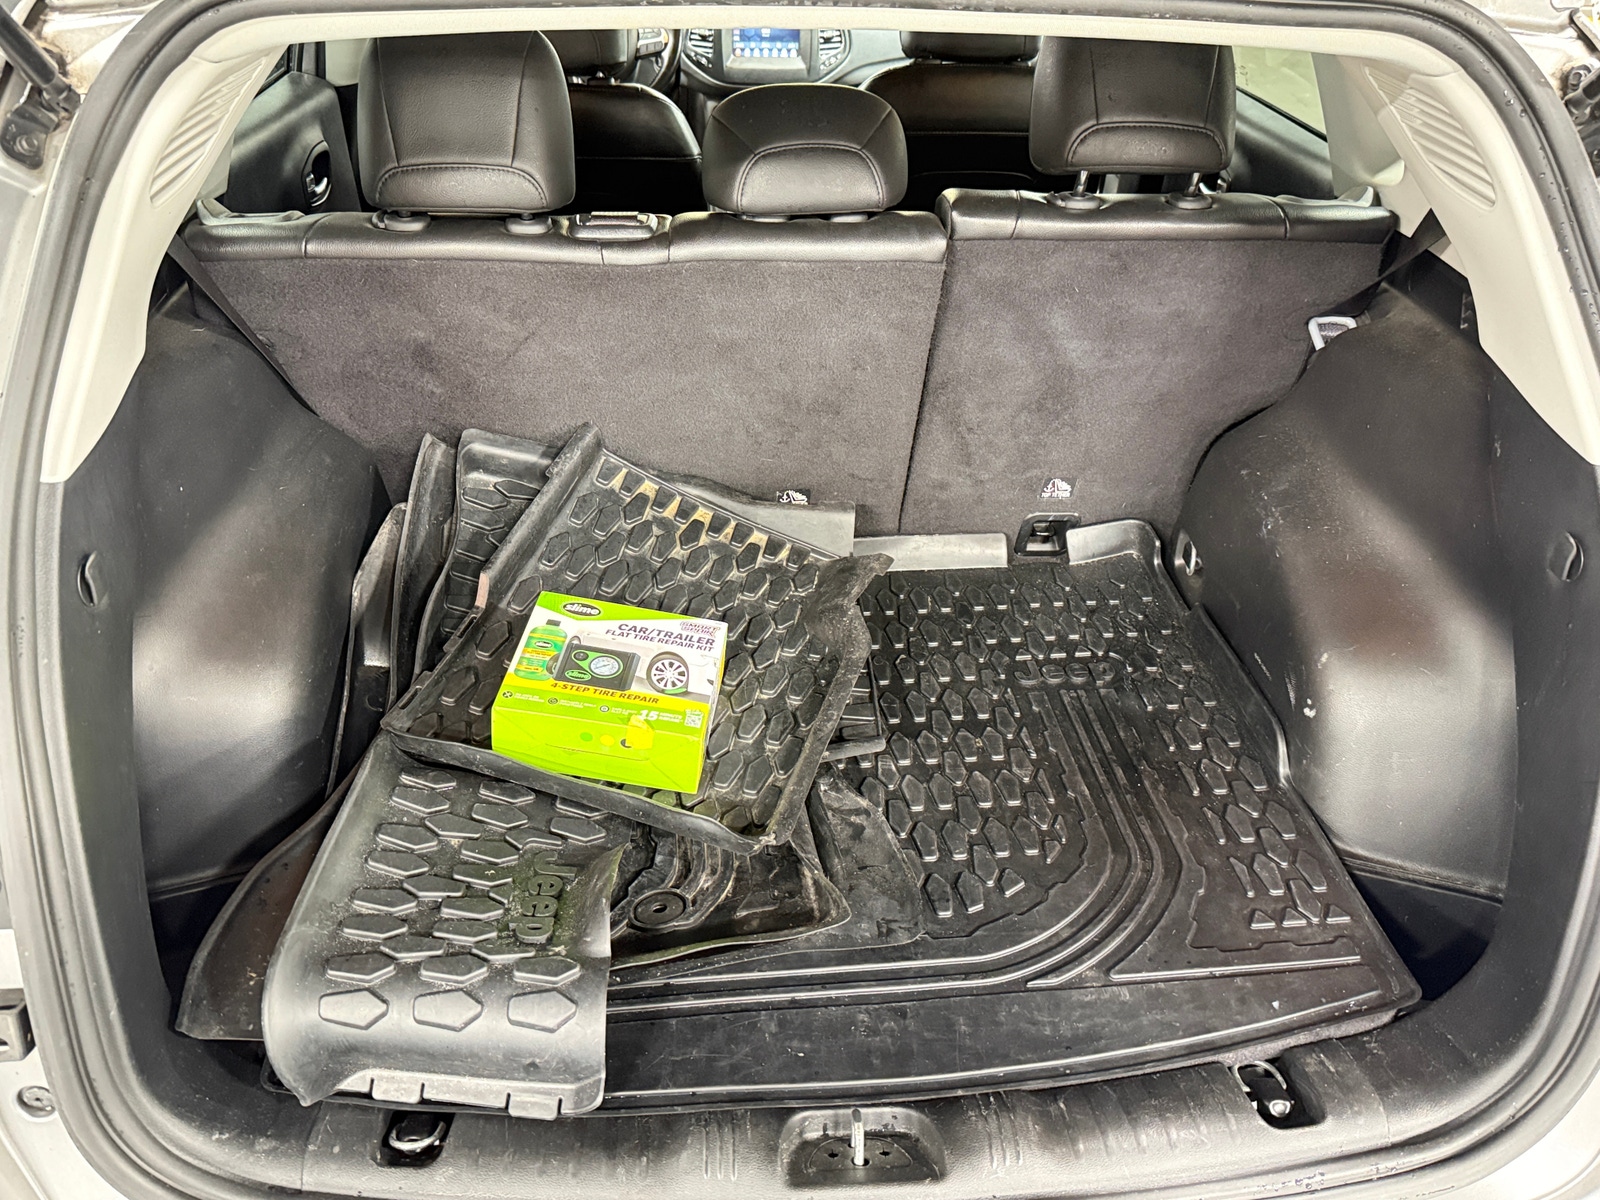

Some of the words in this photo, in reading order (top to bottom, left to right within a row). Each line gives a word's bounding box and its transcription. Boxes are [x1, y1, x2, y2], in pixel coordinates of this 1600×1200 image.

[564, 603, 600, 615] slime
[605, 629, 632, 639] FLAT
[633, 633, 656, 643] TIRE
[657, 637, 695, 649] REPAIR
[618, 623, 716, 646] CAR/TRAILER
[1013, 660, 1116, 686] Jeep
[551, 682, 590, 693] 4-STEP
[593, 688, 618, 698] TIRE
[619, 692, 660, 704] REPAIR
[639, 709, 659, 721] 15
[509, 850, 578, 943] Jeep
